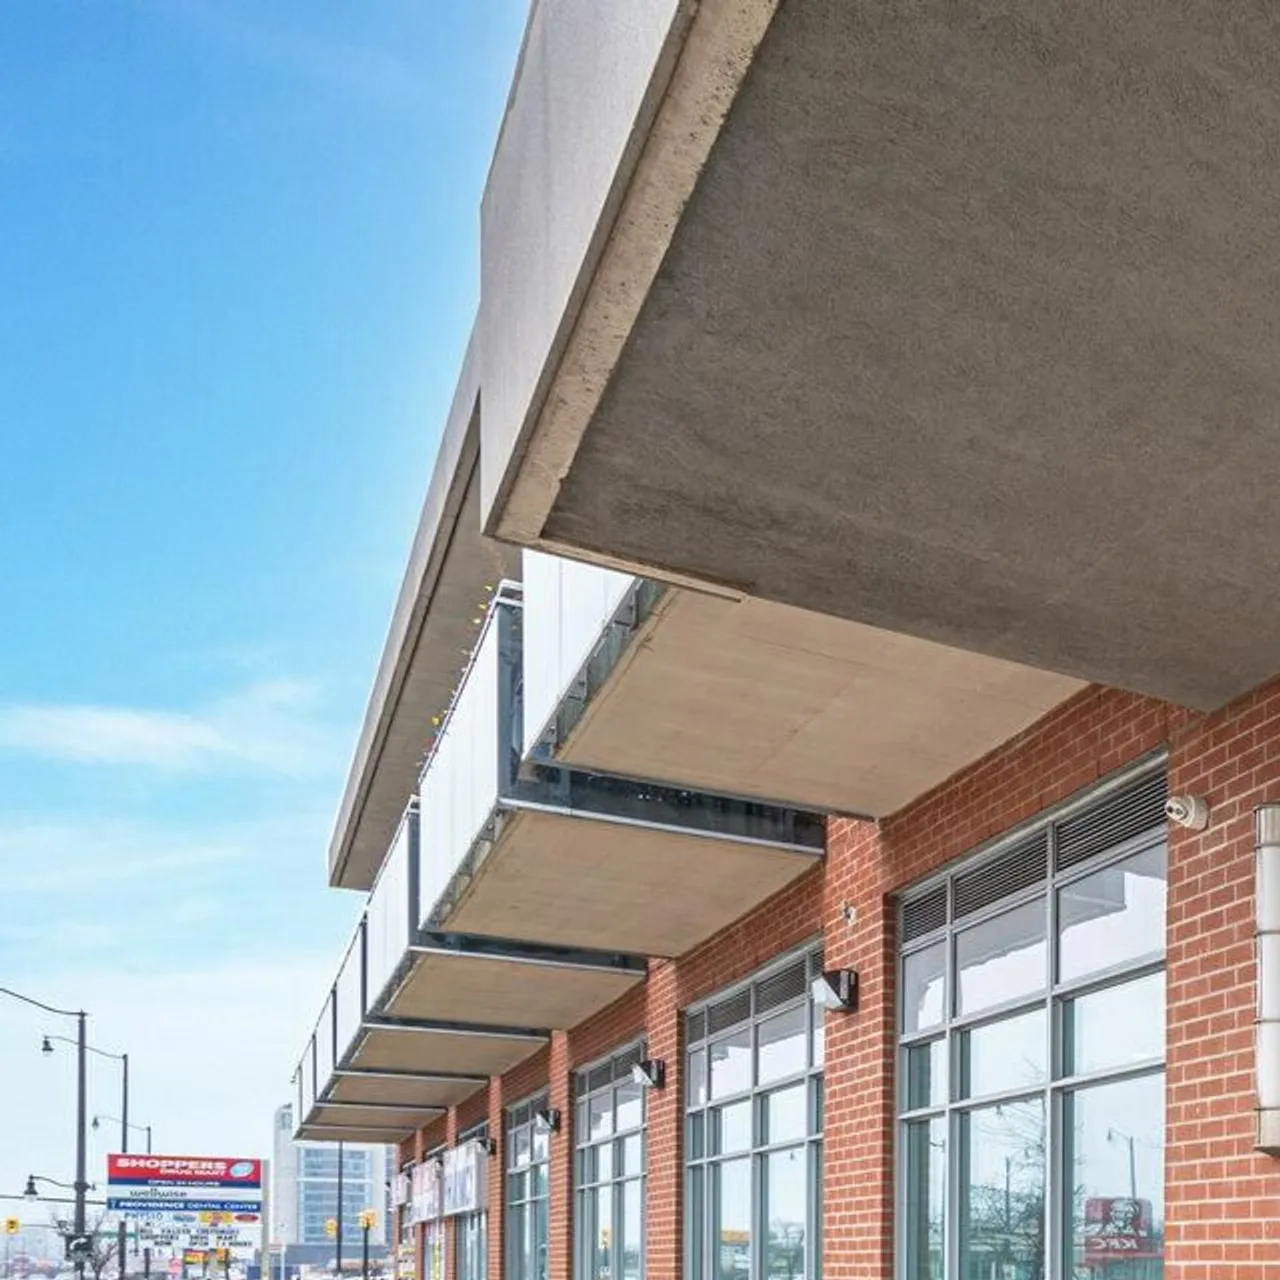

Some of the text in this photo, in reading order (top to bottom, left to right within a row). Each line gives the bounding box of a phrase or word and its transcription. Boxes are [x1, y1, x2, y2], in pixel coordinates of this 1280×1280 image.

[116, 1158, 227, 1170] SHOPPERS
[130, 1188, 188, 1197] wellwise
[119, 1201, 185, 1210] PROVIDENCE
